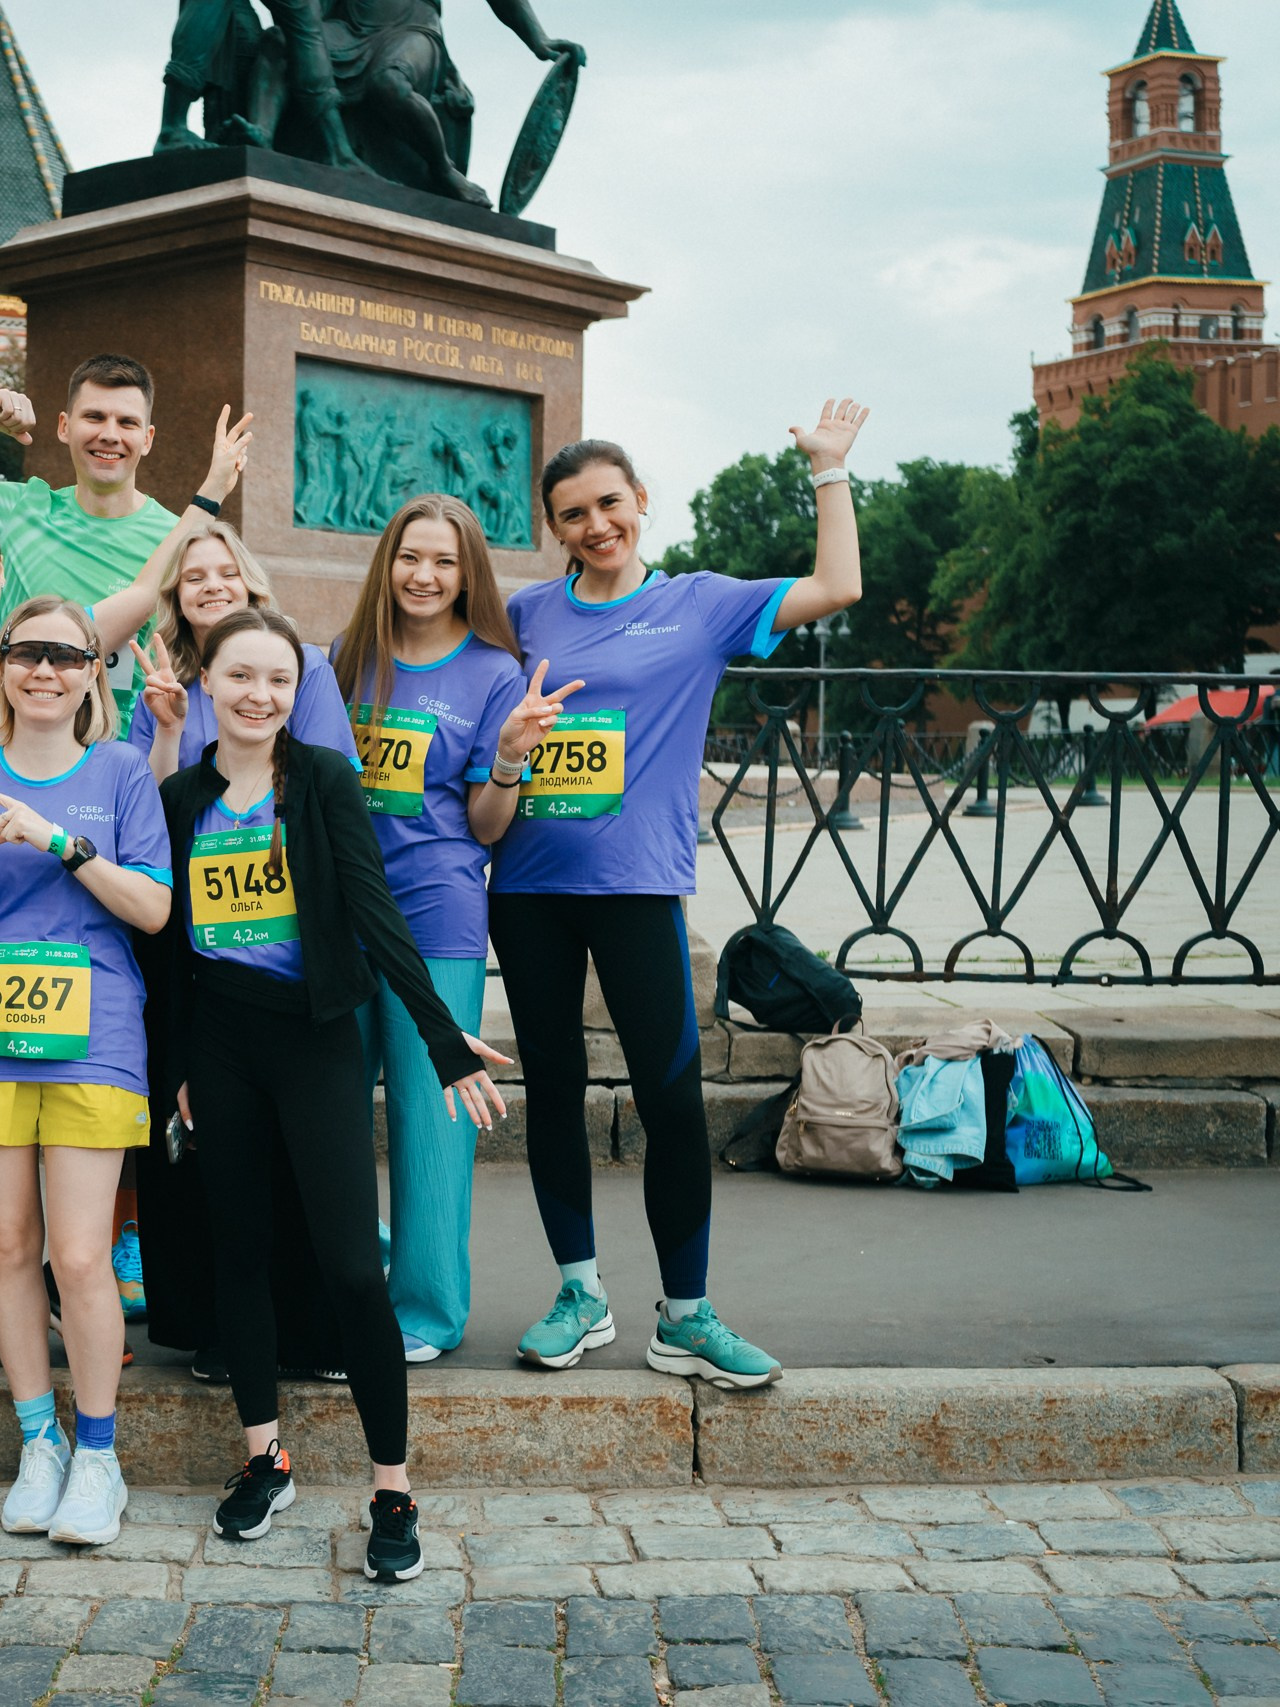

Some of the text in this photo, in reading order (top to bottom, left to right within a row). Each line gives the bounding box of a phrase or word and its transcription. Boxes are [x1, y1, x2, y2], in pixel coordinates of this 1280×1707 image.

[423, 312, 434, 331] И
[300, 322, 397, 356] БЛАГОДАРНАЯ
[625, 624, 681, 636] МАРКЕТИНГ
[429, 699, 451, 711] СБЕР
[425, 706, 476, 729] МАРКЕТИНГ
[354, 734, 412, 770] 270
[530, 740, 607, 775] 2758
[539, 776, 593, 788] ЛЮДМИЛА
[79, 806, 104, 814] СБЕР
[203, 861, 287, 901] 5148
[230, 901, 263, 913] ОЛЬГА
[203, 927, 217, 946] E
[6, 1013, 46, 1024] СОФЬЯ
